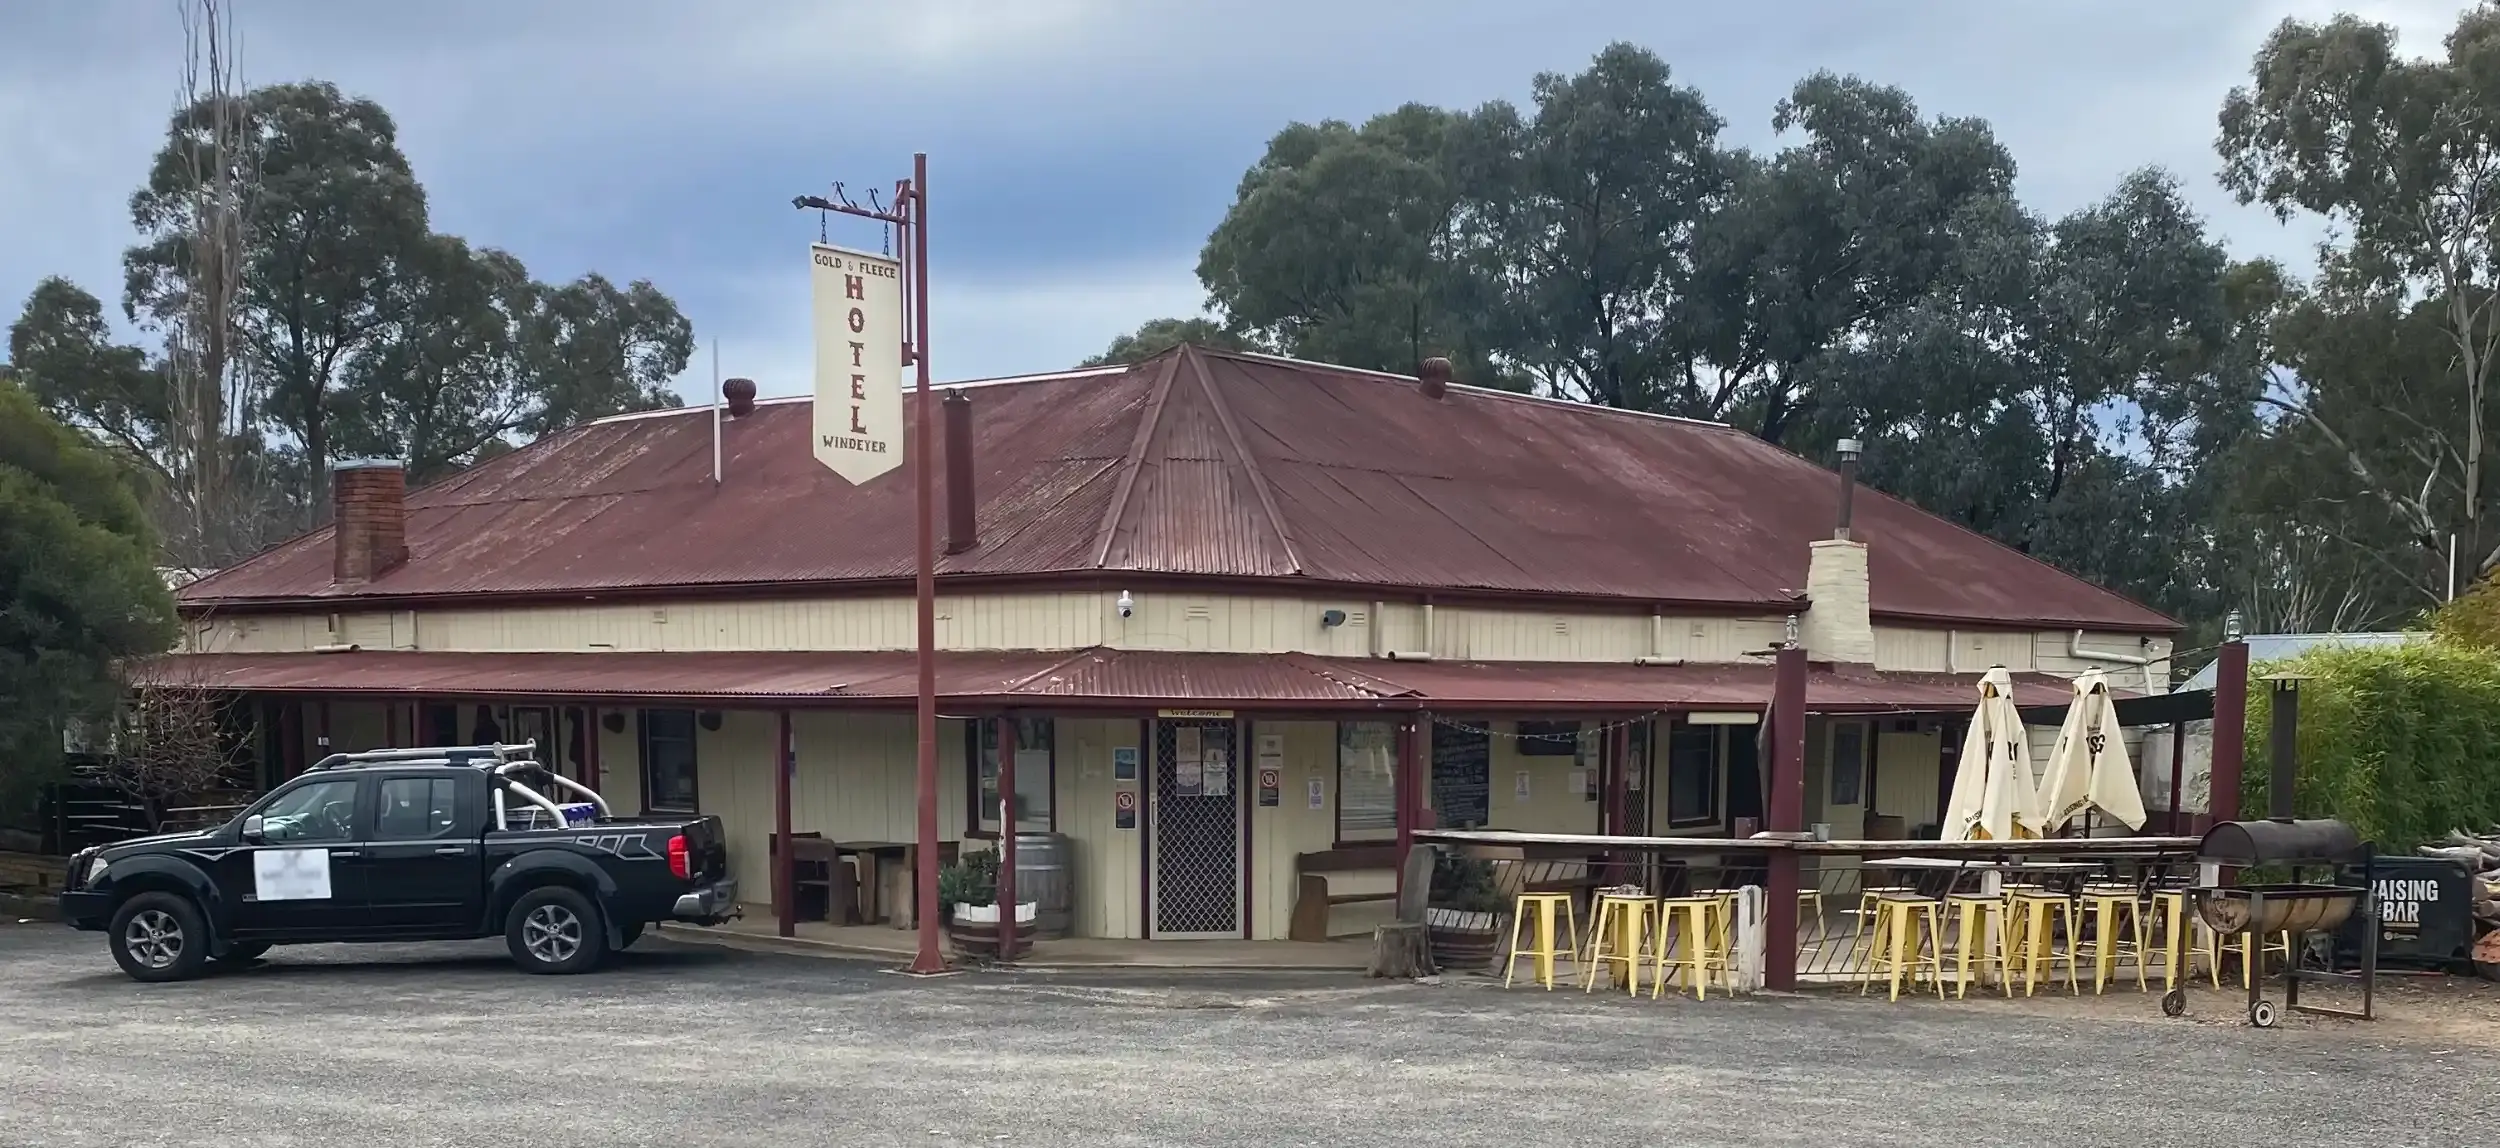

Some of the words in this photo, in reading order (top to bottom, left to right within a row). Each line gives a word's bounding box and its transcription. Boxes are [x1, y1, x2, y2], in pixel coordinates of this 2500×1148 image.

[814, 253, 842, 269] GOLD
[847, 260, 854, 272] &
[859, 261, 896, 279] FLEECE
[844, 273, 867, 435] HOTEL
[822, 434, 887, 454] WINDEYER
[2382, 901, 2420, 922] BAR
